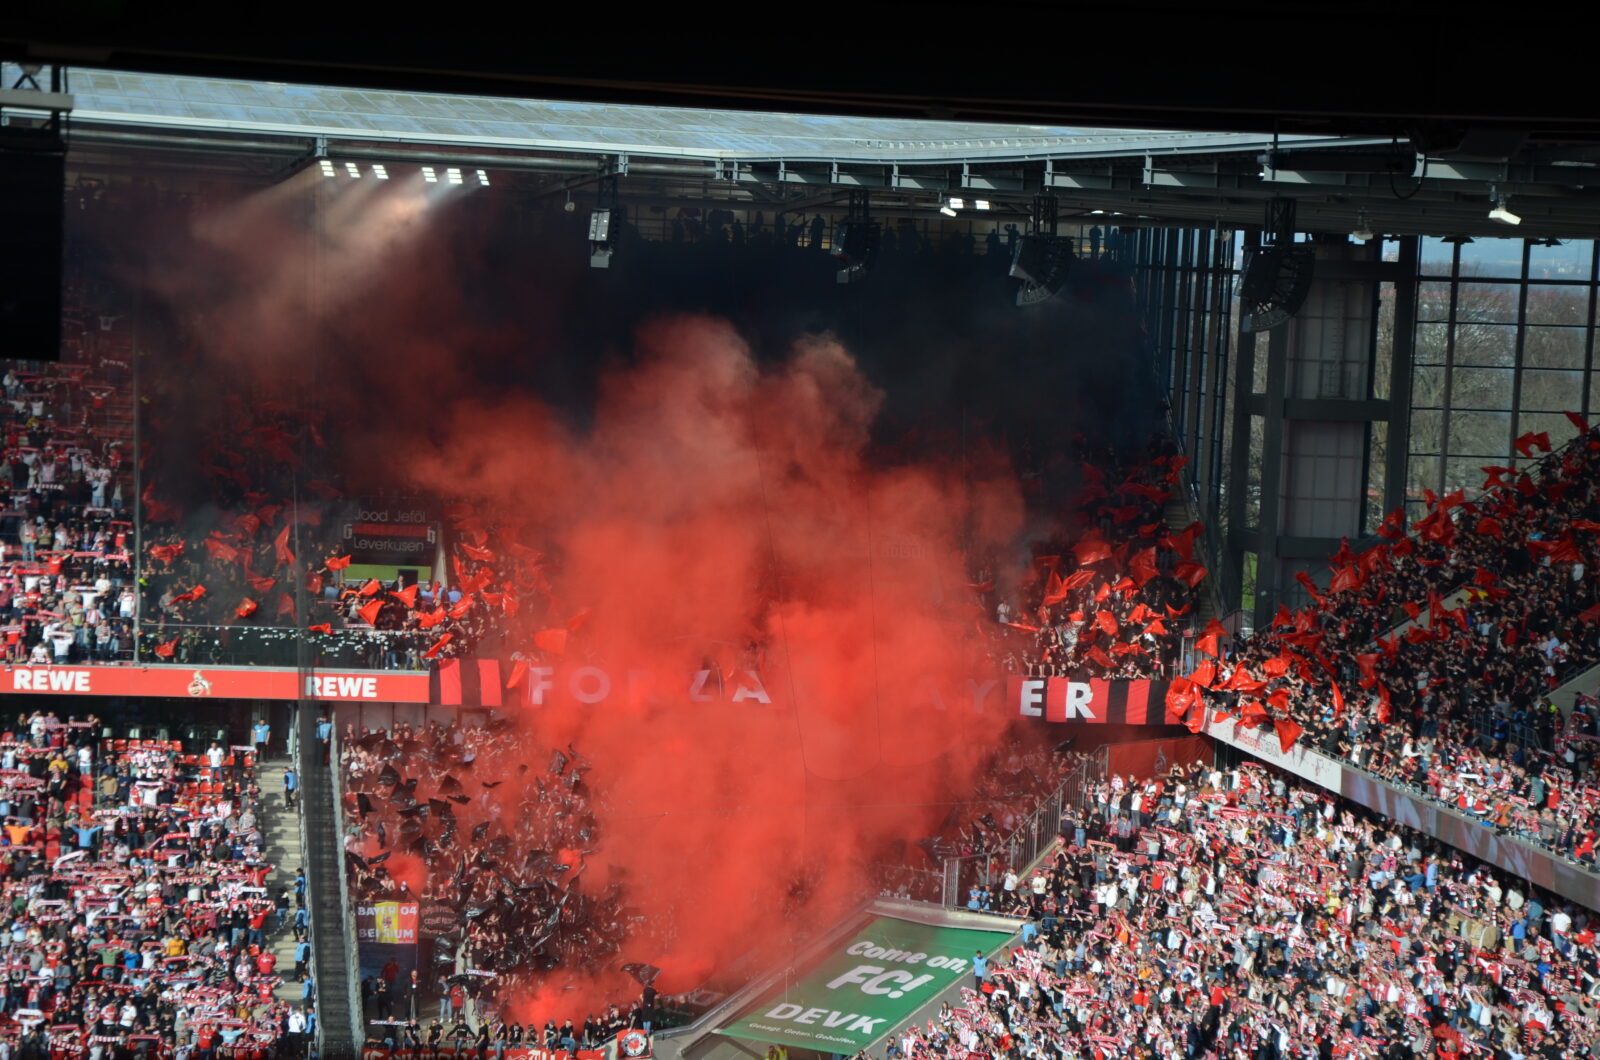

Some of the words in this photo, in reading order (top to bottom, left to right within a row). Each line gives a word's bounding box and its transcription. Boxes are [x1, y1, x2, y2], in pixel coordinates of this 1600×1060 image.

[354, 537, 424, 552] Leverkusen
[14, 669, 91, 691] REWE
[305, 676, 377, 698] REWE
[400, 906, 417, 915] 04
[846, 941, 928, 964] Come
[926, 955, 968, 973] on,
[826, 965, 935, 999] FC!
[764, 1003, 888, 1034] DEVK
